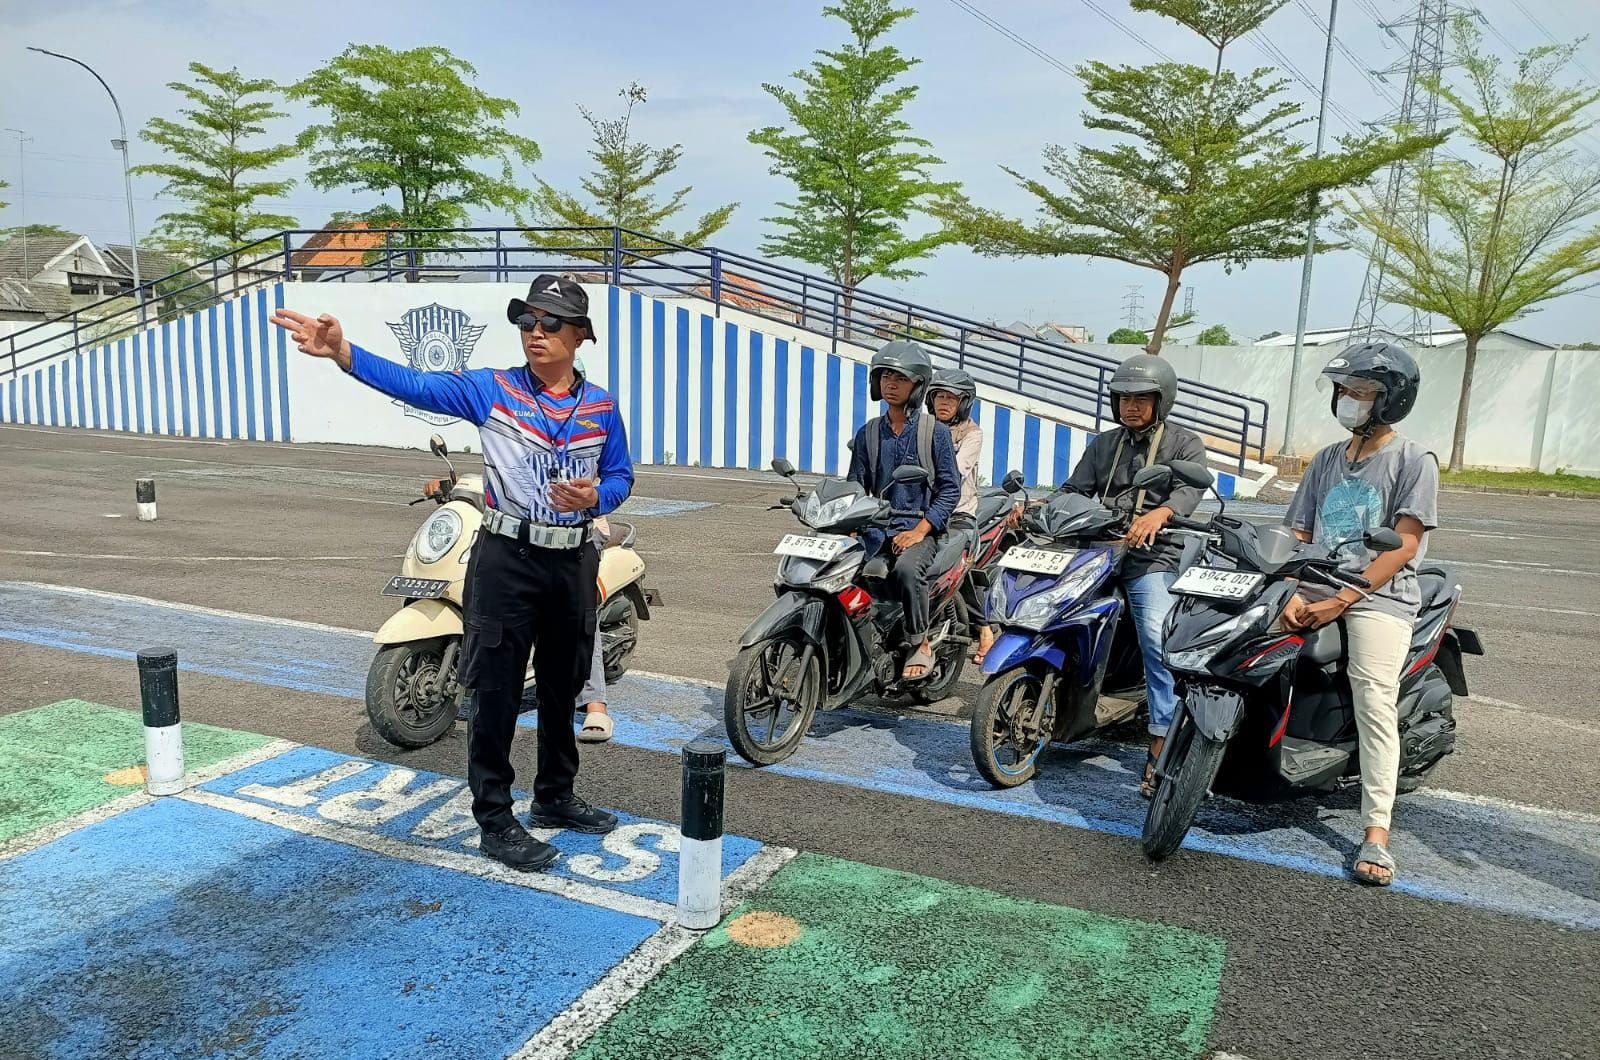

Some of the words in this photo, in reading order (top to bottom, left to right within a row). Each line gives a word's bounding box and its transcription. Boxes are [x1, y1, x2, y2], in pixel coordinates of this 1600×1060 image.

[1009, 548, 1017, 556] S
[1021, 550, 1047, 560] 4015
[1185, 568, 1195, 578] S
[1199, 570, 1230, 582] 6944
[391, 578, 400, 588] S
[401, 579, 429, 589] 3253
